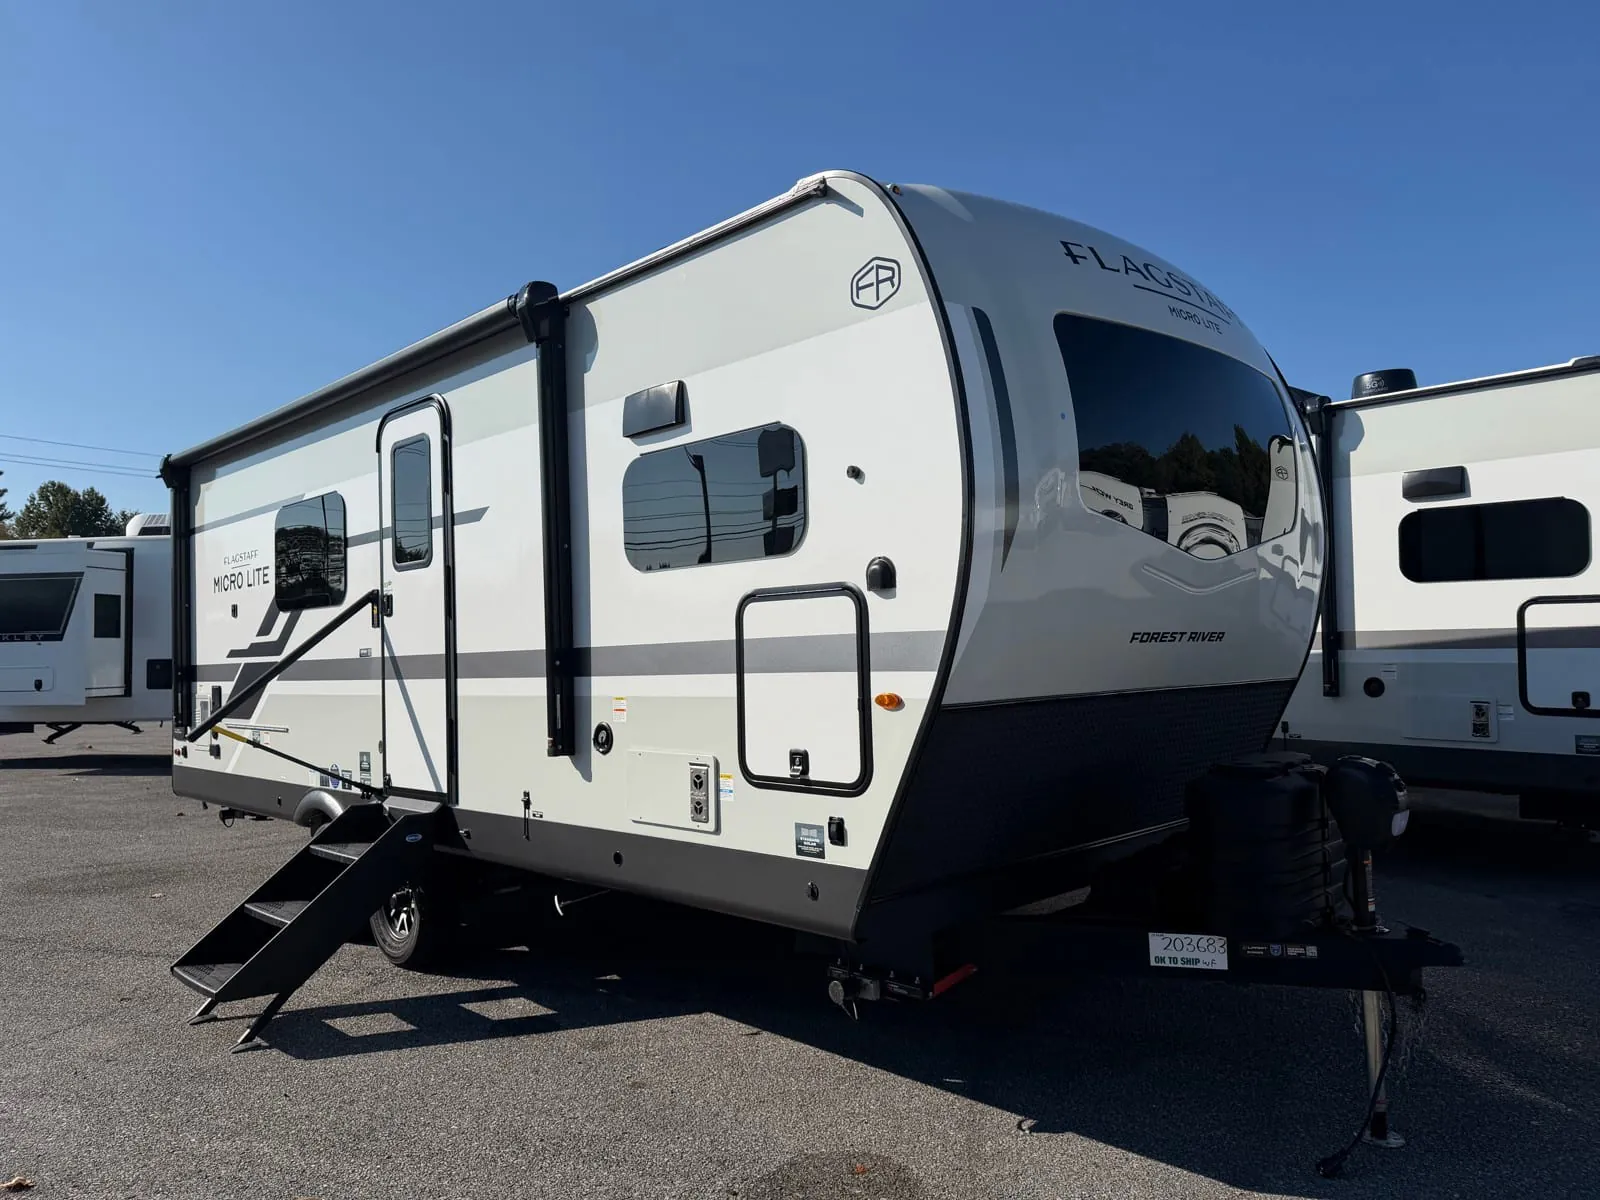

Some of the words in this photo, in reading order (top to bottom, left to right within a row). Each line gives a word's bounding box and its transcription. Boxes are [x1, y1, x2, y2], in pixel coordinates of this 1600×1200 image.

[1167, 304, 1201, 325] MICRO
[1201, 318, 1223, 335] LITE
[223, 549, 259, 566] FLAGSTAFF
[213, 571, 243, 593] MICRO
[247, 565, 270, 587] LITE
[1129, 631, 1187, 644] FOREST
[1187, 631, 1226, 643] RIVER
[1161, 936, 1227, 955] 203683
[1154, 955, 1167, 965] OK
[1168, 956, 1179, 965] TO
[1180, 957, 1200, 967] SHIP
